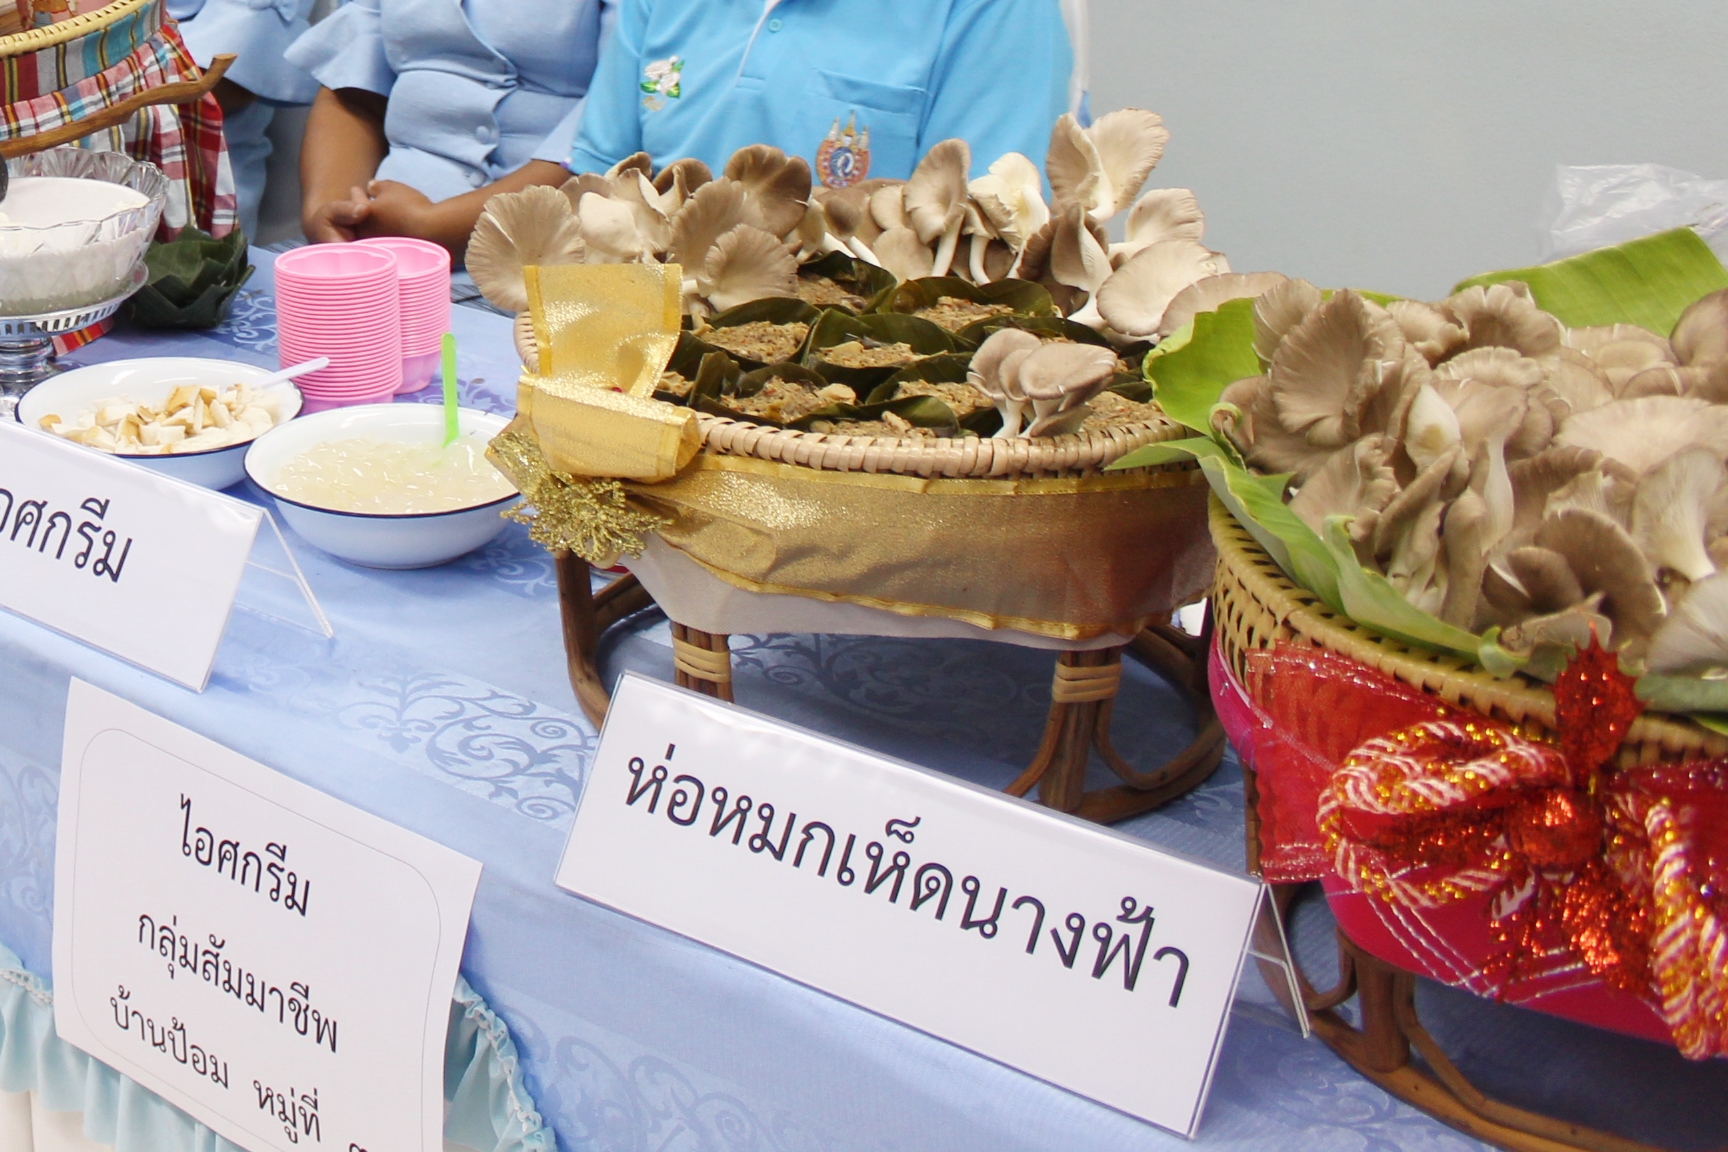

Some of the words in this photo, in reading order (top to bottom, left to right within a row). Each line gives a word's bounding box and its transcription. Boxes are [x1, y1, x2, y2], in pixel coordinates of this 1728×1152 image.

[180, 792, 311, 918] ไอศกรีม
[624, 743, 1190, 1010] ห่อหมกเห็ดนางฟ้า
[137, 913, 338, 1054] กลุ่มสัมมาชีพ
[110, 984, 229, 1090] บ้านป้อม
[252, 1086, 321, 1144] หมู่ที่
